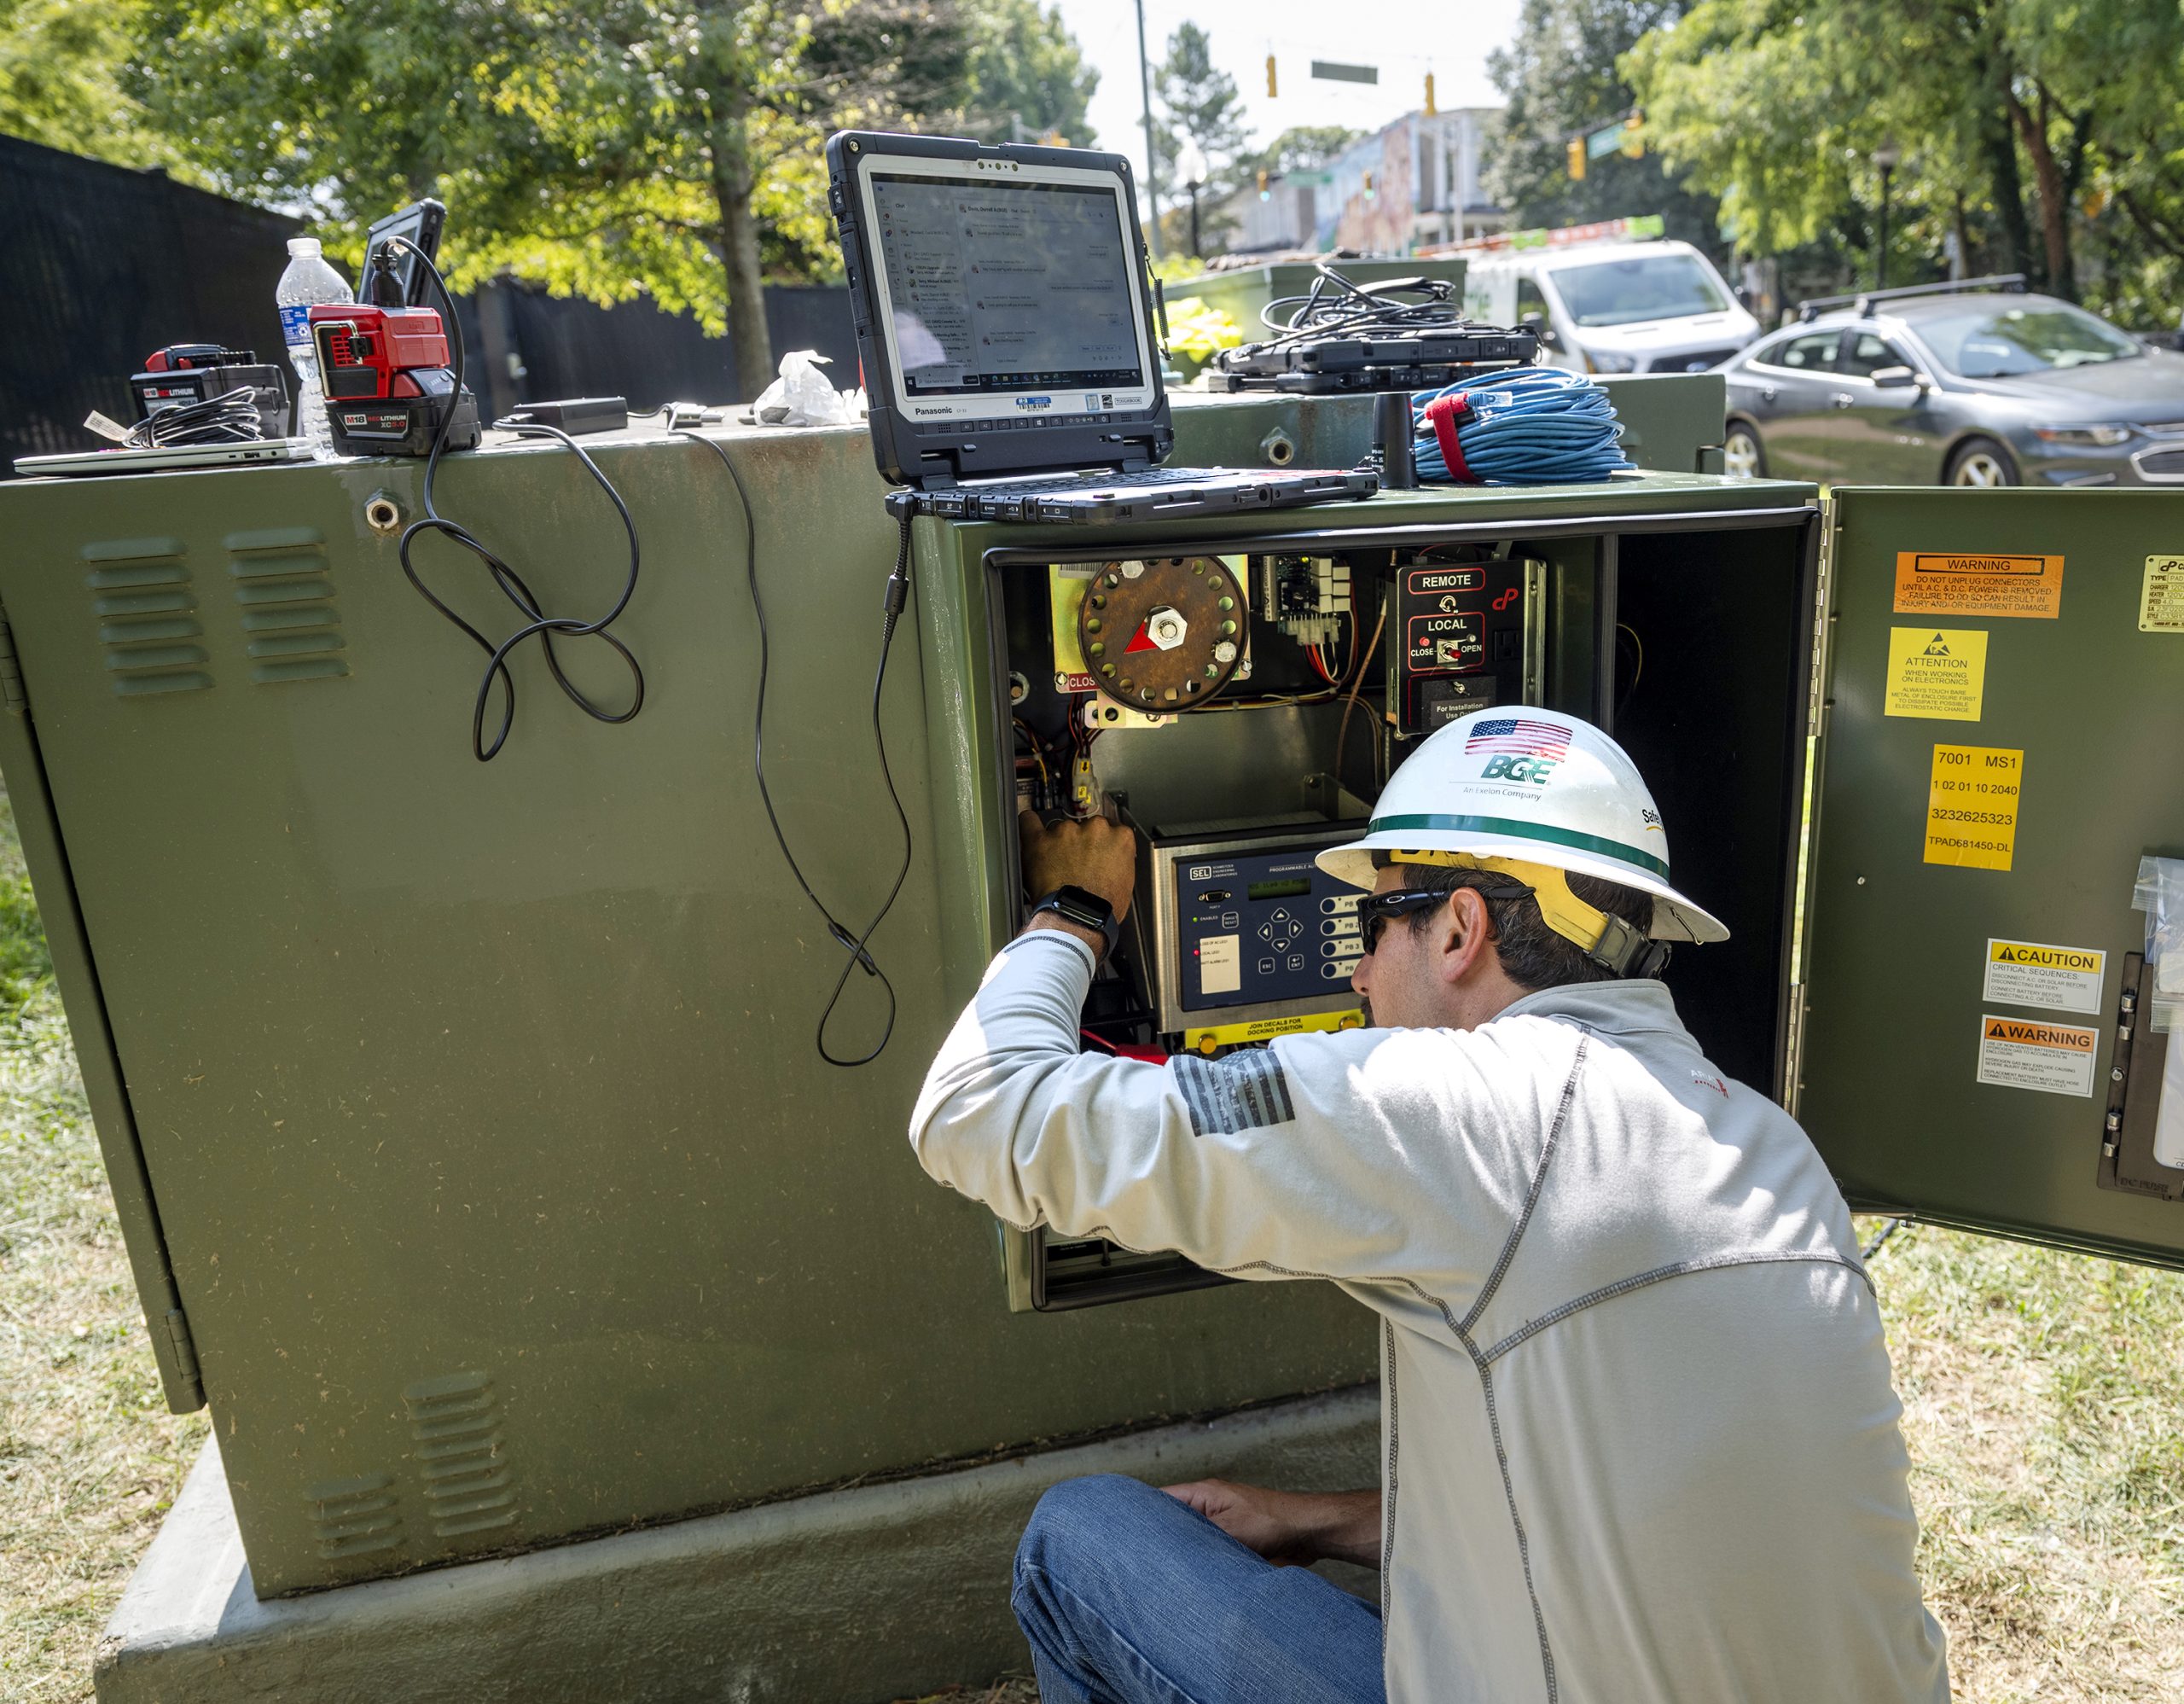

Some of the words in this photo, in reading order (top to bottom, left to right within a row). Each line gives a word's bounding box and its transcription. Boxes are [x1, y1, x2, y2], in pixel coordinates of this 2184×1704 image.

[915, 406, 952, 415] Panasonic
[1948, 560, 2010, 570] WARNING
[1422, 575, 1471, 588] REMOTE
[1428, 619, 1467, 631] LOCAL
[1411, 648, 1433, 657] CLOSE
[1906, 658, 1967, 668] ATTENTION
[1069, 675, 1095, 687] CLOS
[1938, 752, 1971, 765] 7001
[1986, 756, 2016, 769] MS1
[1481, 755, 1556, 784] BGE
[1943, 781, 1955, 790] 02
[1958, 782, 1971, 791] 01
[1976, 783, 1988, 793] 10
[1991, 785, 2017, 795] 2040
[1502, 788, 1541, 802] Company
[1931, 809, 2013, 825] 3232625323
[1929, 836, 2011, 852] TPAD681450-DL
[2018, 949, 2094, 968] CAUTION
[1993, 963, 2026, 973] CRITICAL
[2029, 968, 2079, 980] SEQUENCES:
[1991, 978, 2034, 987] DISCONNECTING
[1990, 991, 2024, 1000] CONNECTING
[2009, 1026, 2090, 1047] WARNING
